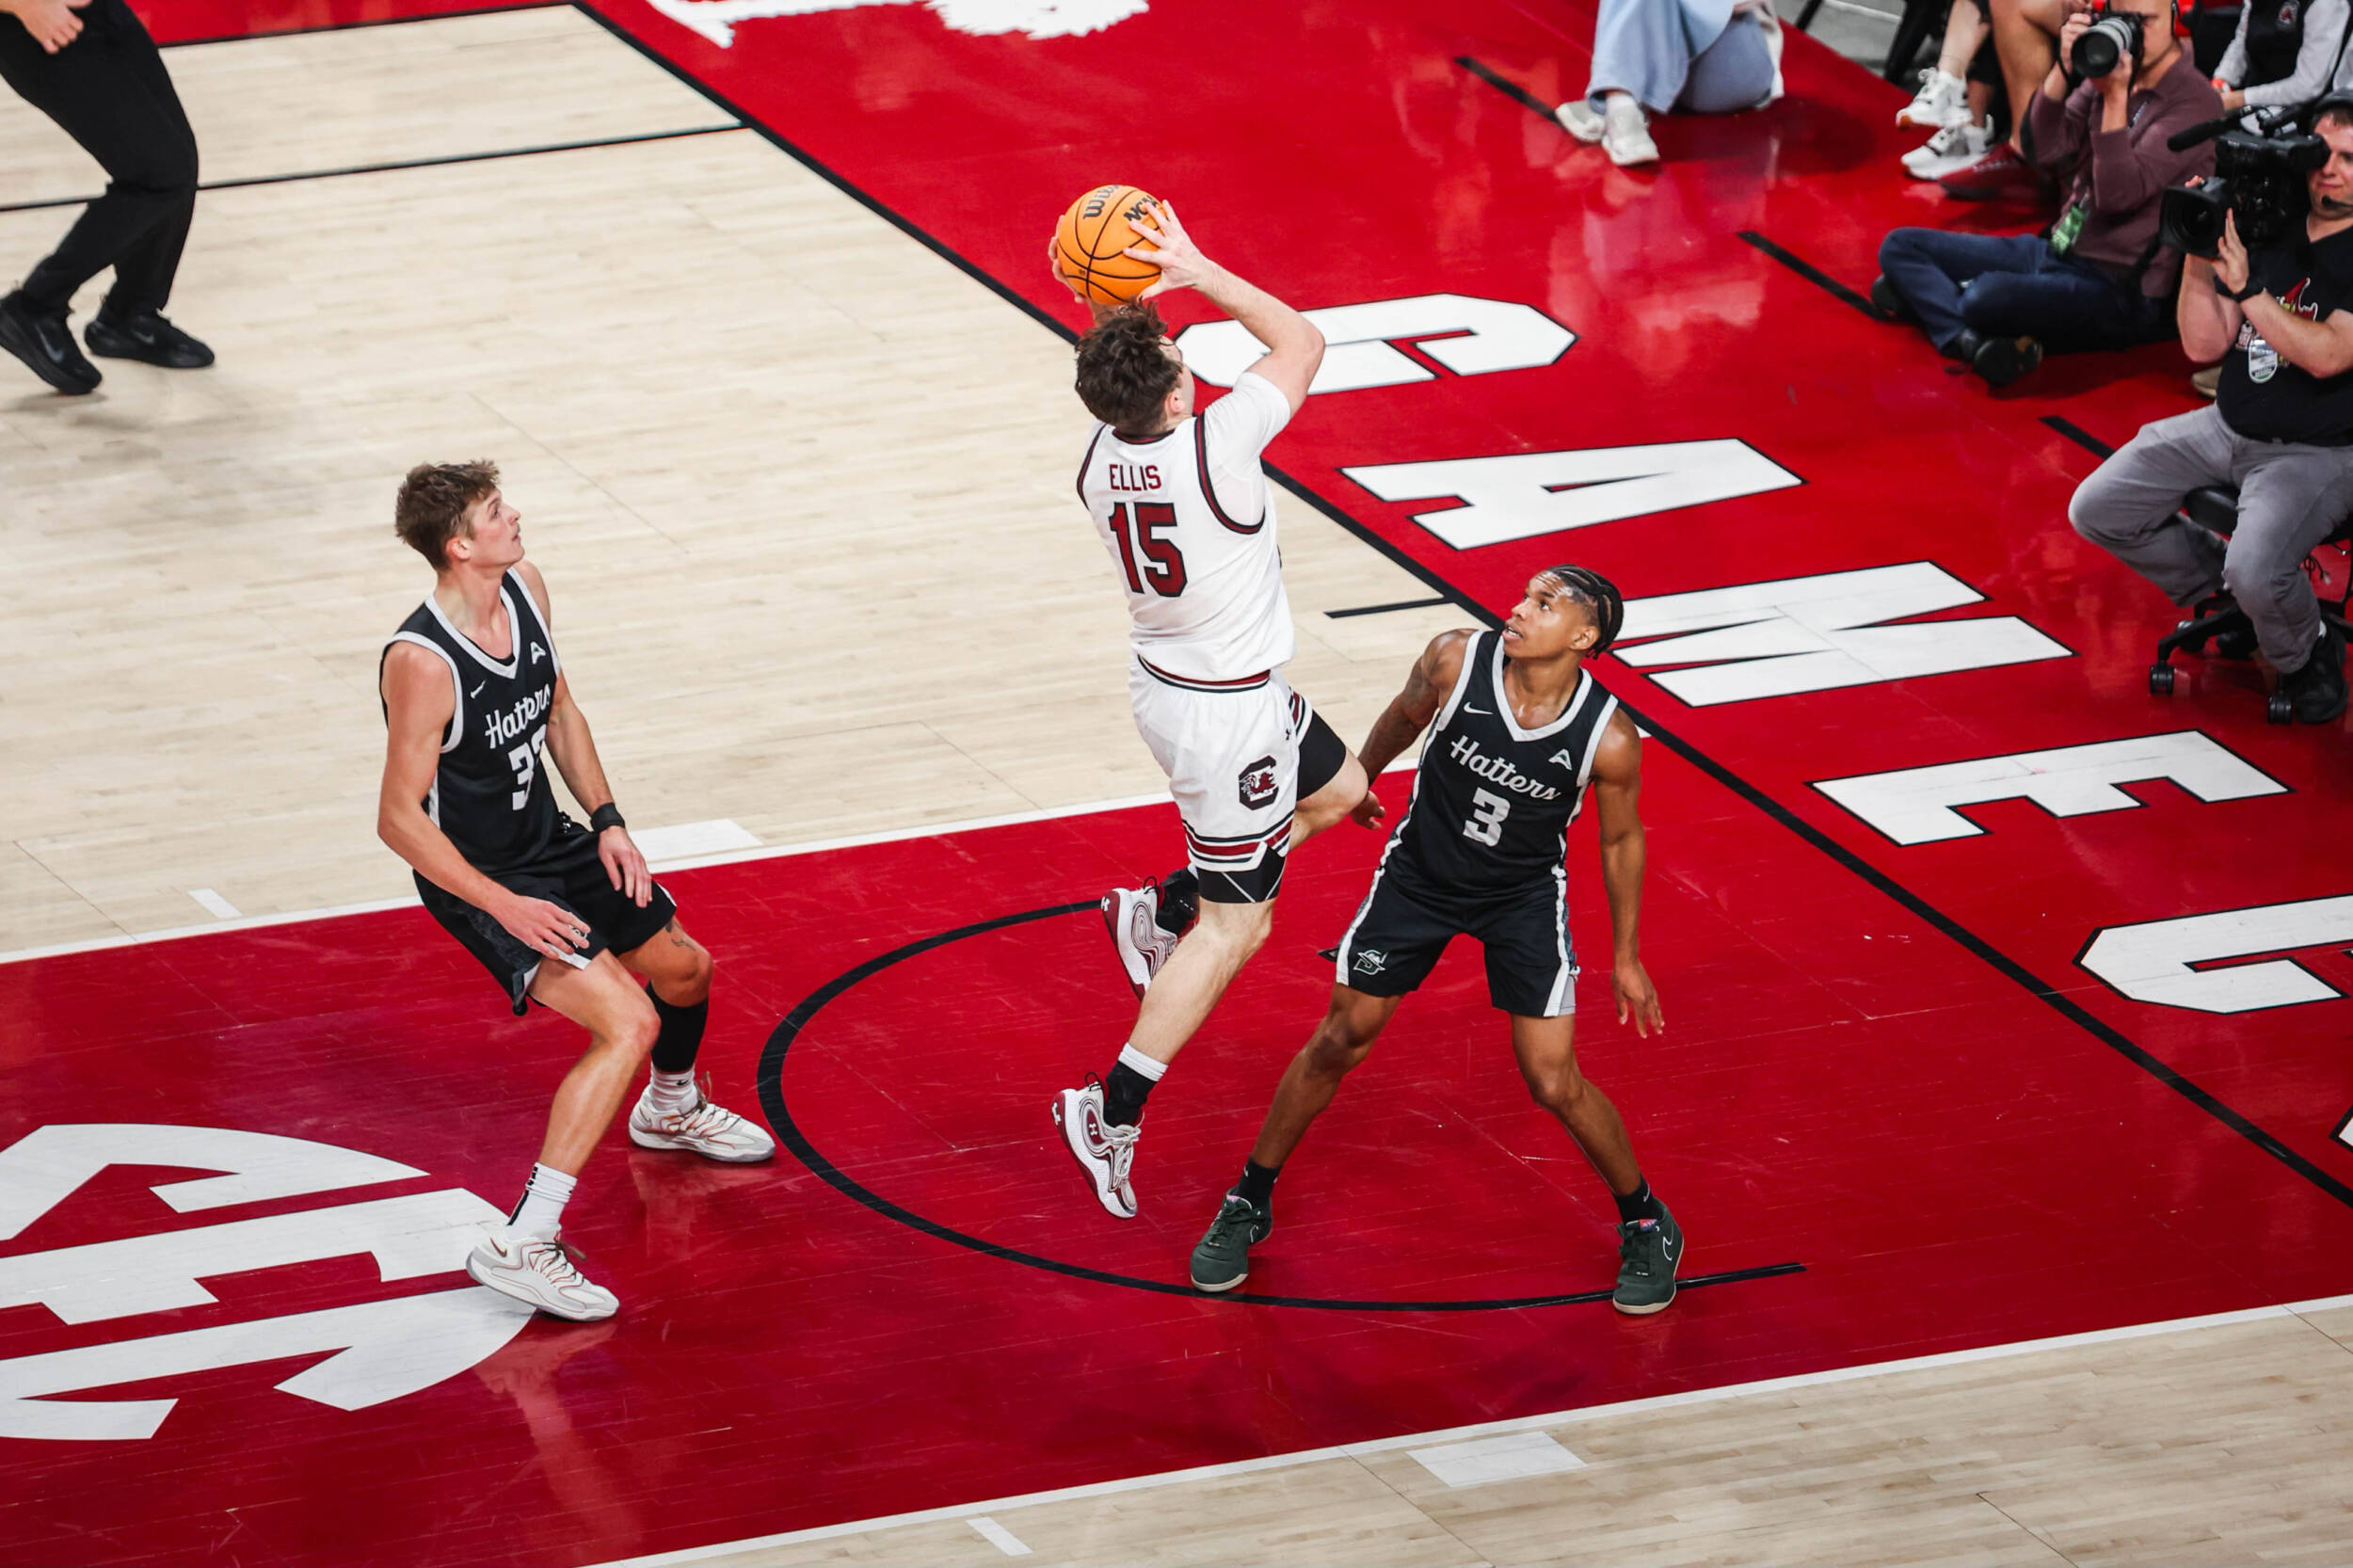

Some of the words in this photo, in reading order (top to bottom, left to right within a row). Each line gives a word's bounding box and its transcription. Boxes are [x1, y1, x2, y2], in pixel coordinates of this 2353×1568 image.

[1109, 464, 1161, 490] ELLIS
[1108, 502, 1188, 597] 15
[1174, 293, 2353, 1154] GAMEC
[1450, 735, 1561, 800] Hatters
[1463, 787, 1511, 847] 3
